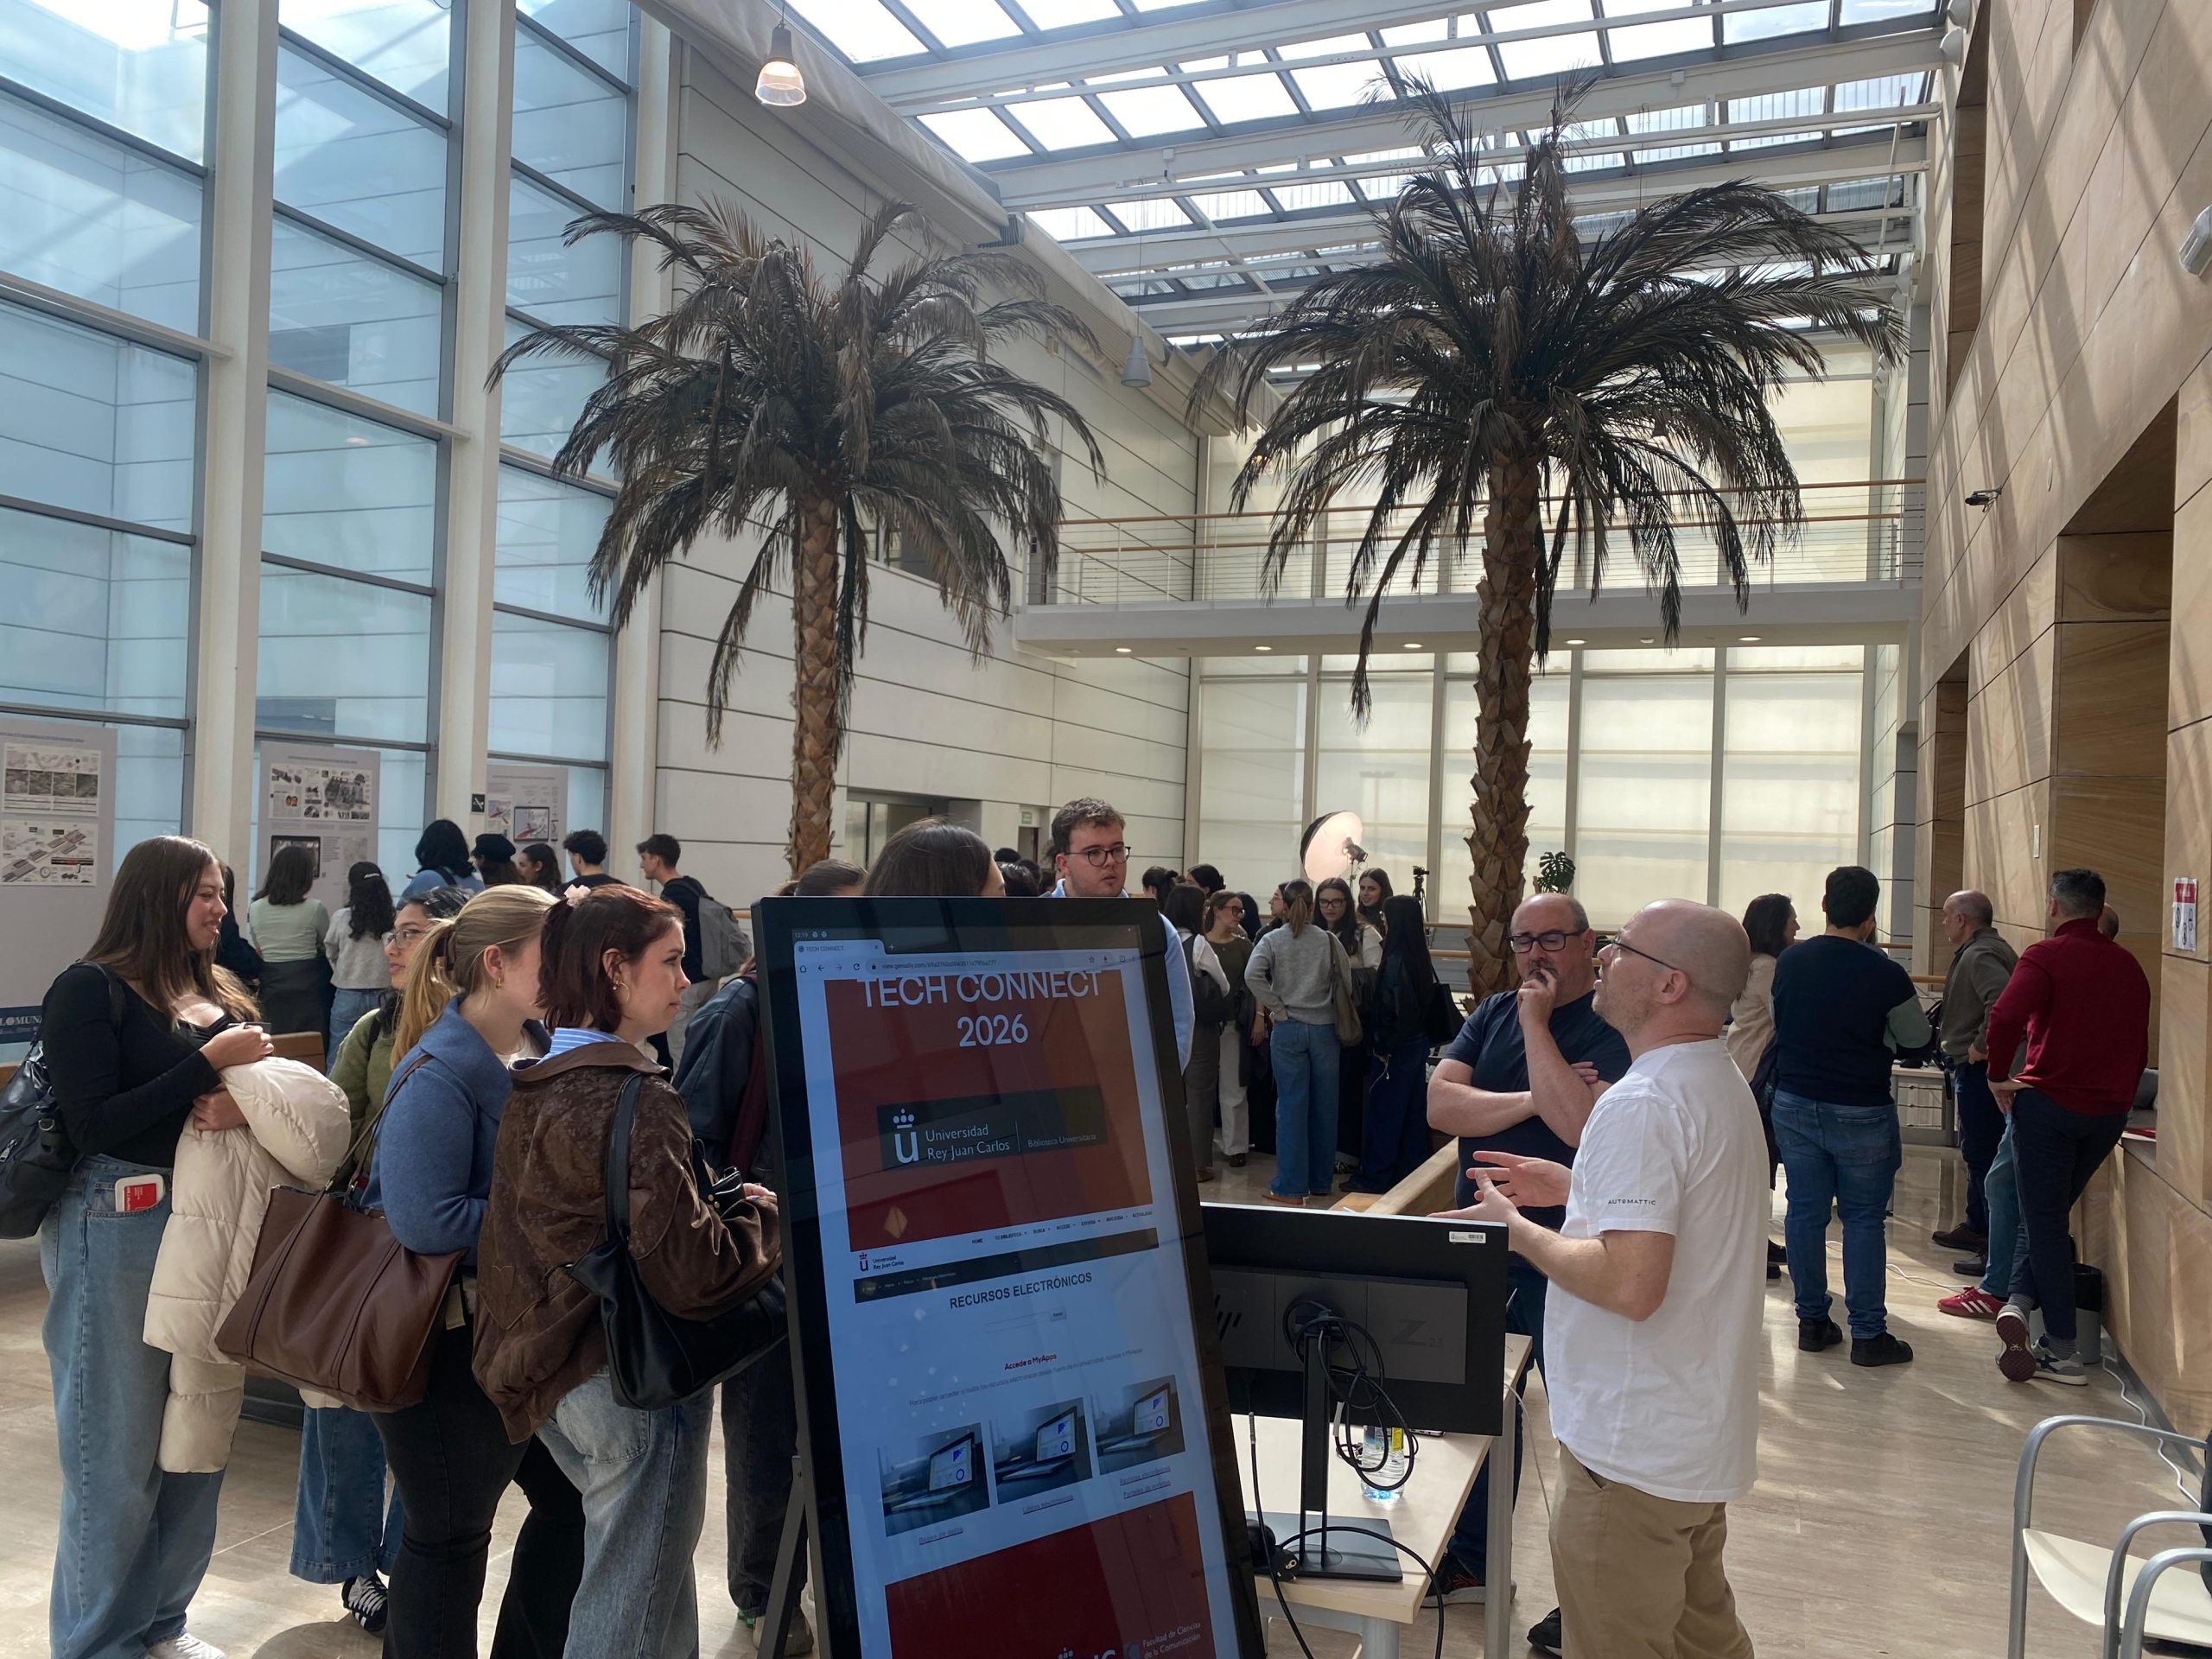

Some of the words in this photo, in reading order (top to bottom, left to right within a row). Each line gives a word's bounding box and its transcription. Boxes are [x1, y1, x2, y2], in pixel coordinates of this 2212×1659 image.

[857, 975, 948, 1007] TECH
[957, 969, 1102, 1003] CONNECT
[957, 1013, 1029, 1047] 2026
[925, 1123, 989, 1142] Universidad
[1027, 1138, 1058, 1148] Biblioteca
[1058, 1134, 1096, 1144] Universitaria
[927, 1147, 948, 1161] Rey
[950, 1145, 974, 1161] Juan
[976, 1140, 1010, 1154] Carlos
[872, 1255, 897, 1264] Universidad
[950, 1287, 1010, 1310] RECURSOS
[1013, 1272, 1092, 1297] ELECTRÓNICOS
[1004, 1359, 1027, 1370] Accede
[1033, 1353, 1058, 1365] MyApps
[1142, 1630, 1167, 1649] Facultad
[1168, 1630, 1176, 1639] de
[1177, 1622, 1201, 1635] Ciencias
[1144, 1649, 1153, 1659] de
[1153, 1647, 1160, 1656] la
[1160, 1633, 1201, 1653] Comunicación
